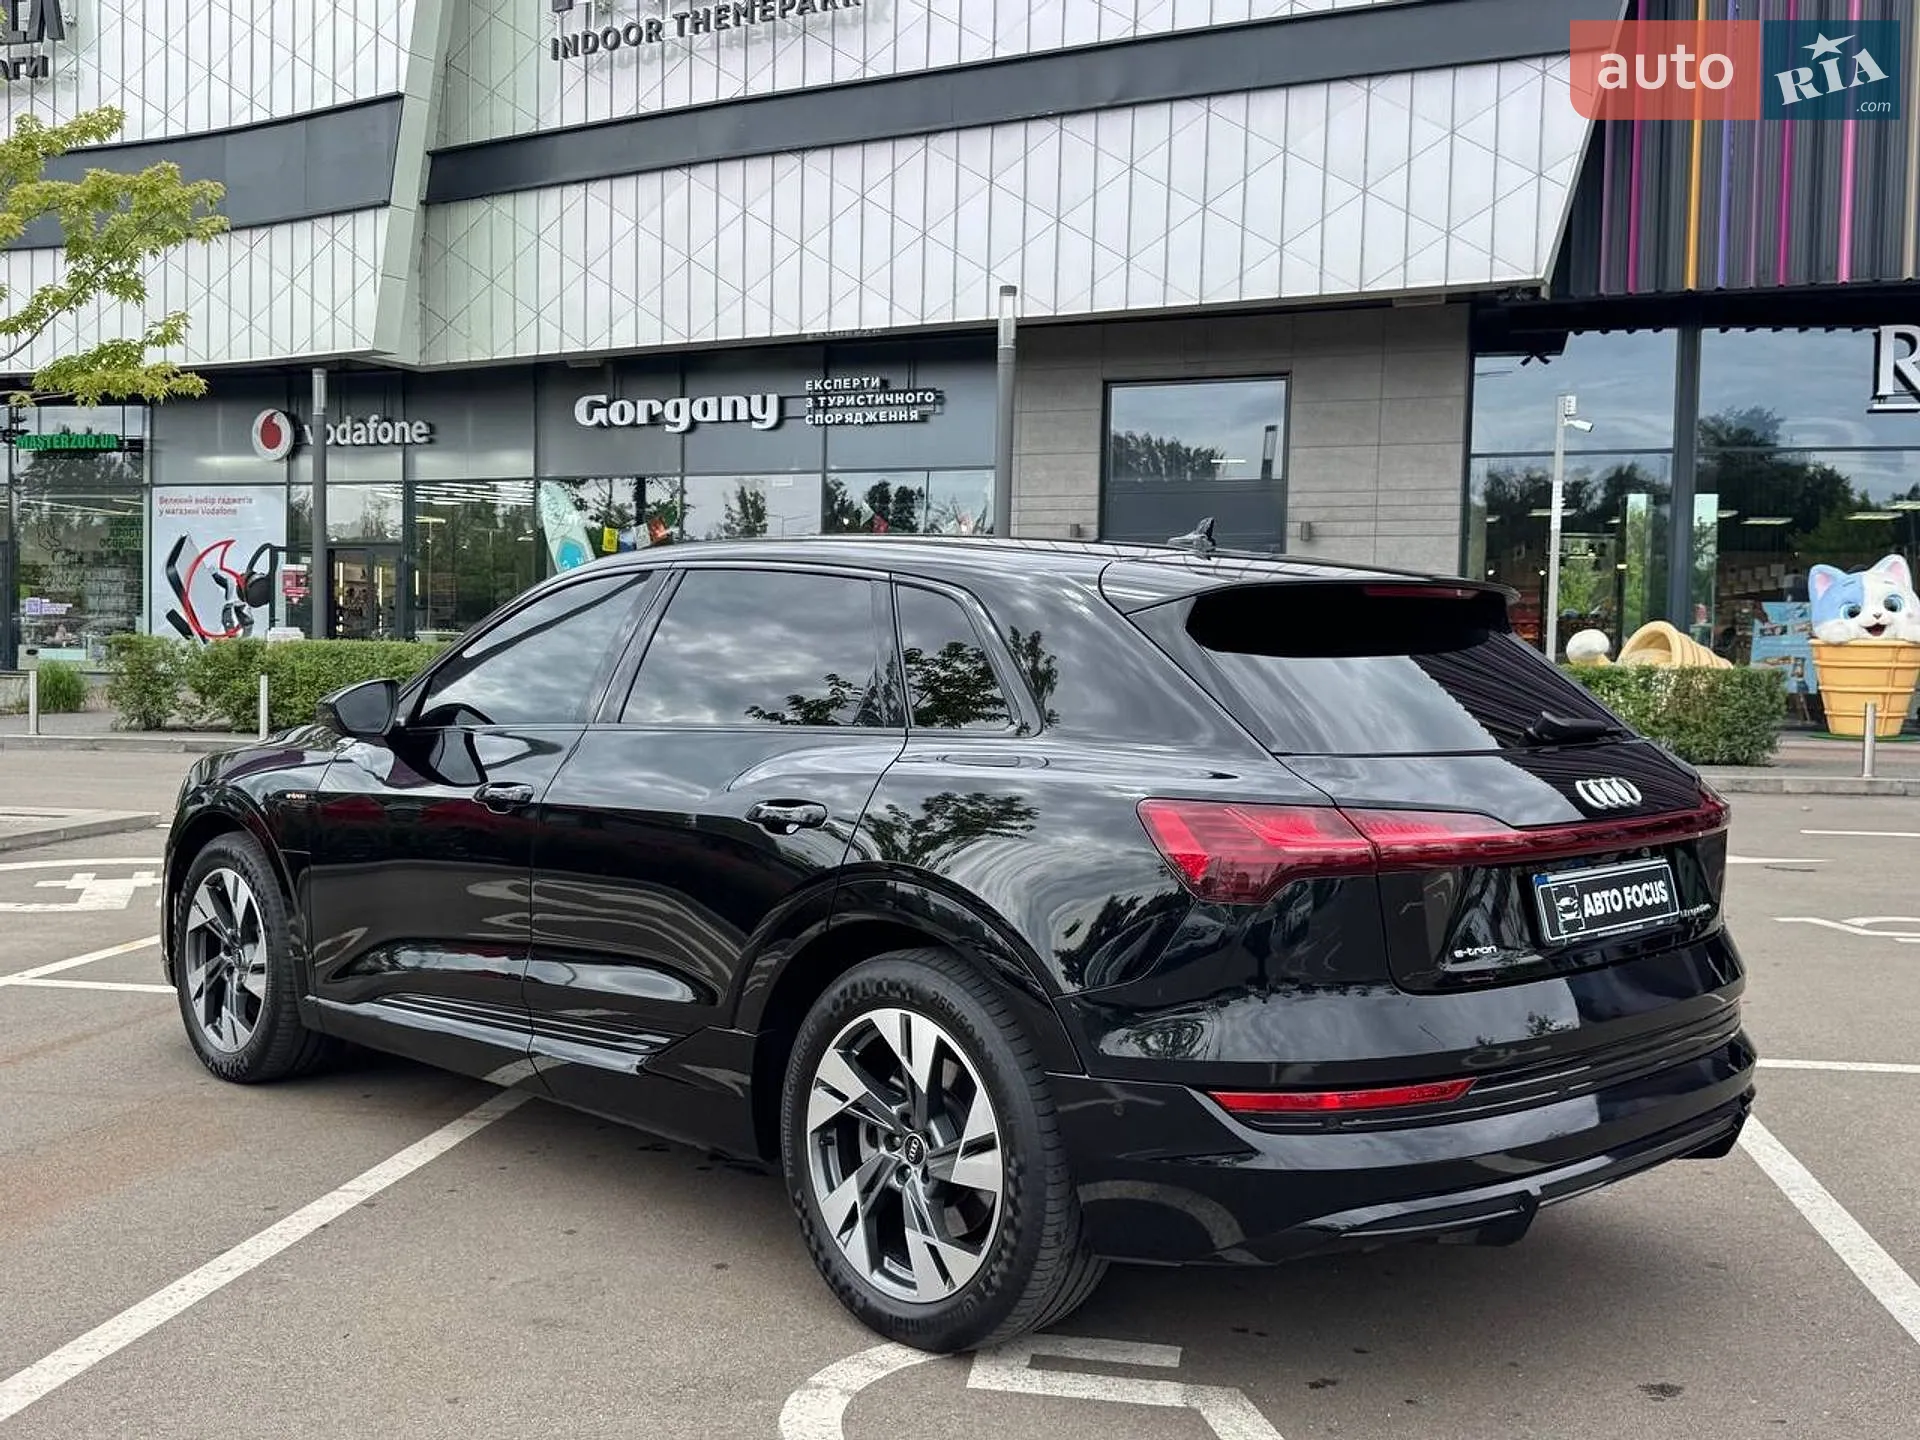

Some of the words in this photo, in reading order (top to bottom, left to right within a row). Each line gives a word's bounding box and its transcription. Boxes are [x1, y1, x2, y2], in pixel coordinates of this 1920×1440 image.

[549, 18, 664, 61] INDOOR
[805, 377, 881, 391] ЕКСПЕРТИ
[818, 392, 936, 407] ТУРИСТИЧНОГО
[574, 394, 779, 433] Gorgany
[805, 410, 919, 425] СПОРЯДЖЕННЯ
[1622, 880, 1670, 910] FOCUS
[1453, 945, 1498, 958] e-tron
